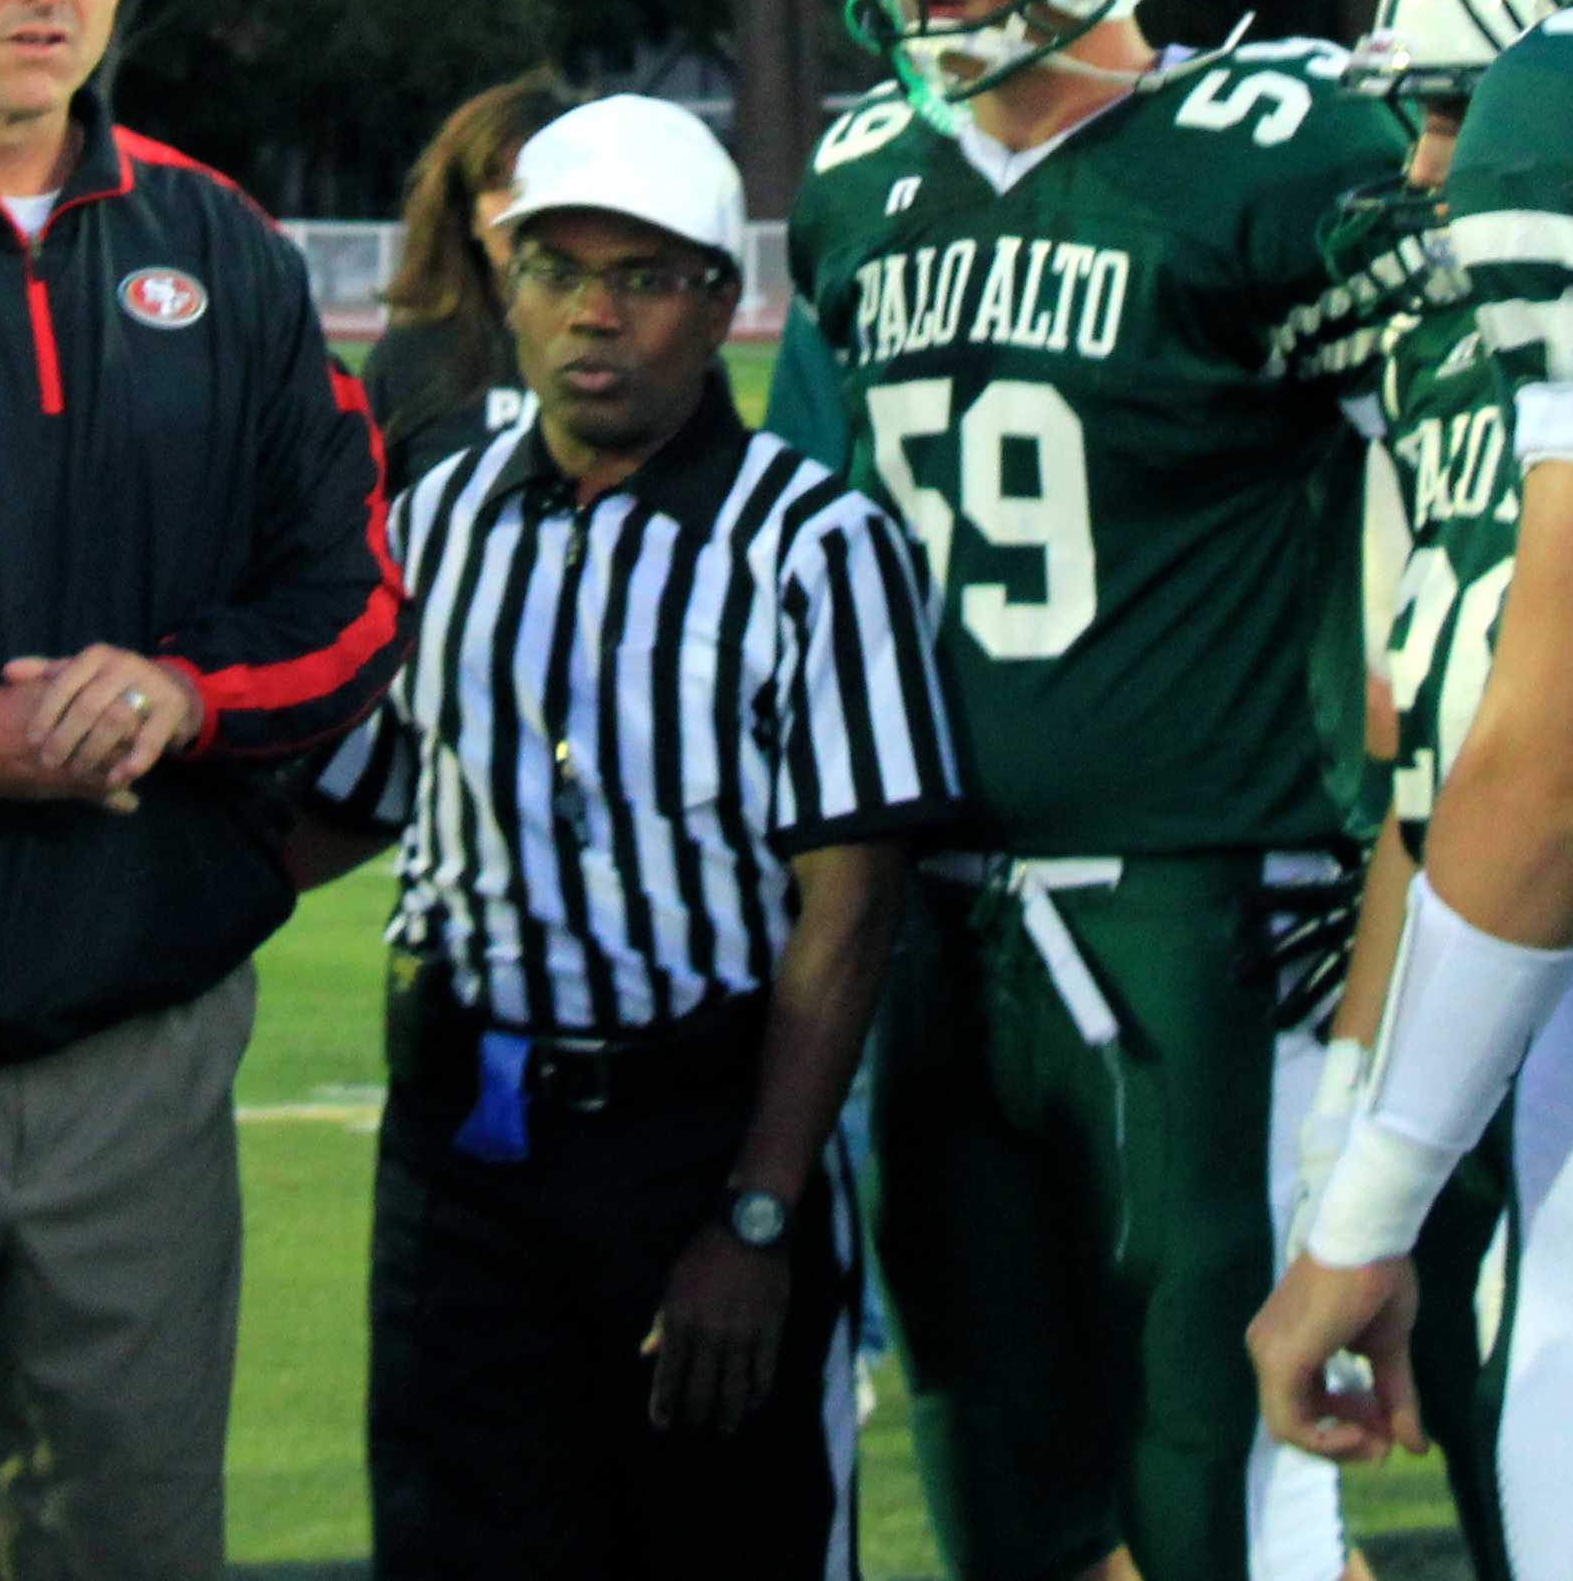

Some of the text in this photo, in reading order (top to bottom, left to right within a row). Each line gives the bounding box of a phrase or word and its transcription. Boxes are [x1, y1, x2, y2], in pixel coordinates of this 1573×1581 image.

[855, 235, 1130, 367] PALO ALTO
[866, 377, 1097, 661] 59
